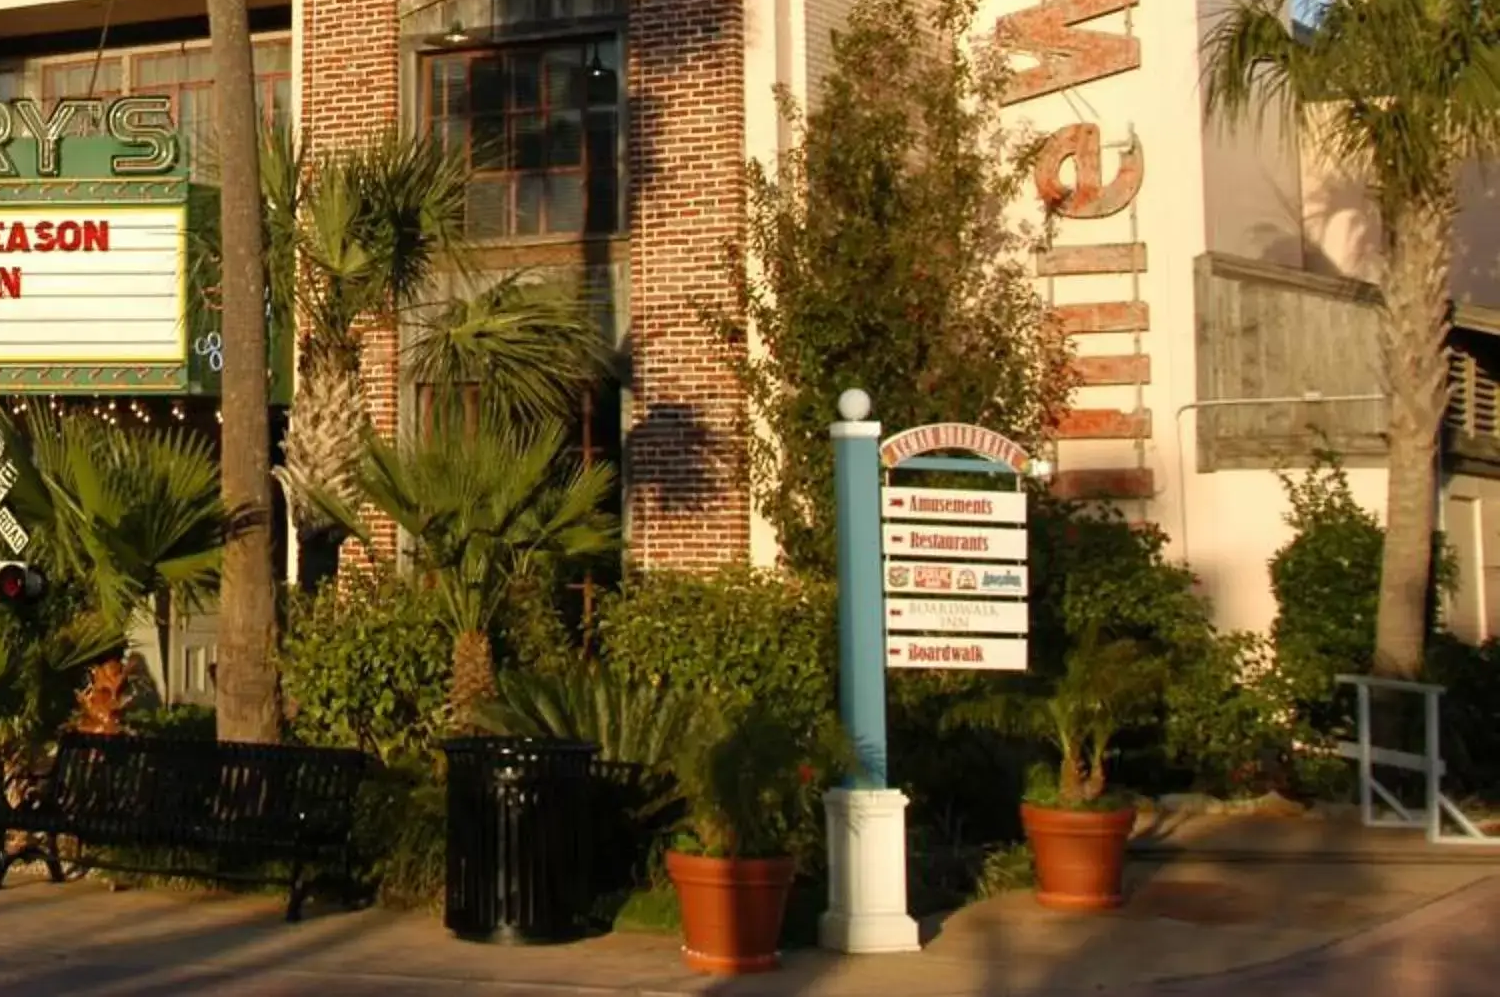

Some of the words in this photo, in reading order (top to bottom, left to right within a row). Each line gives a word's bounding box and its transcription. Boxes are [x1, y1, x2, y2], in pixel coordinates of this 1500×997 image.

[909, 494, 993, 514] Amusements
[909, 531, 989, 551] Restaurants
[907, 643, 984, 662] Boardwalk
